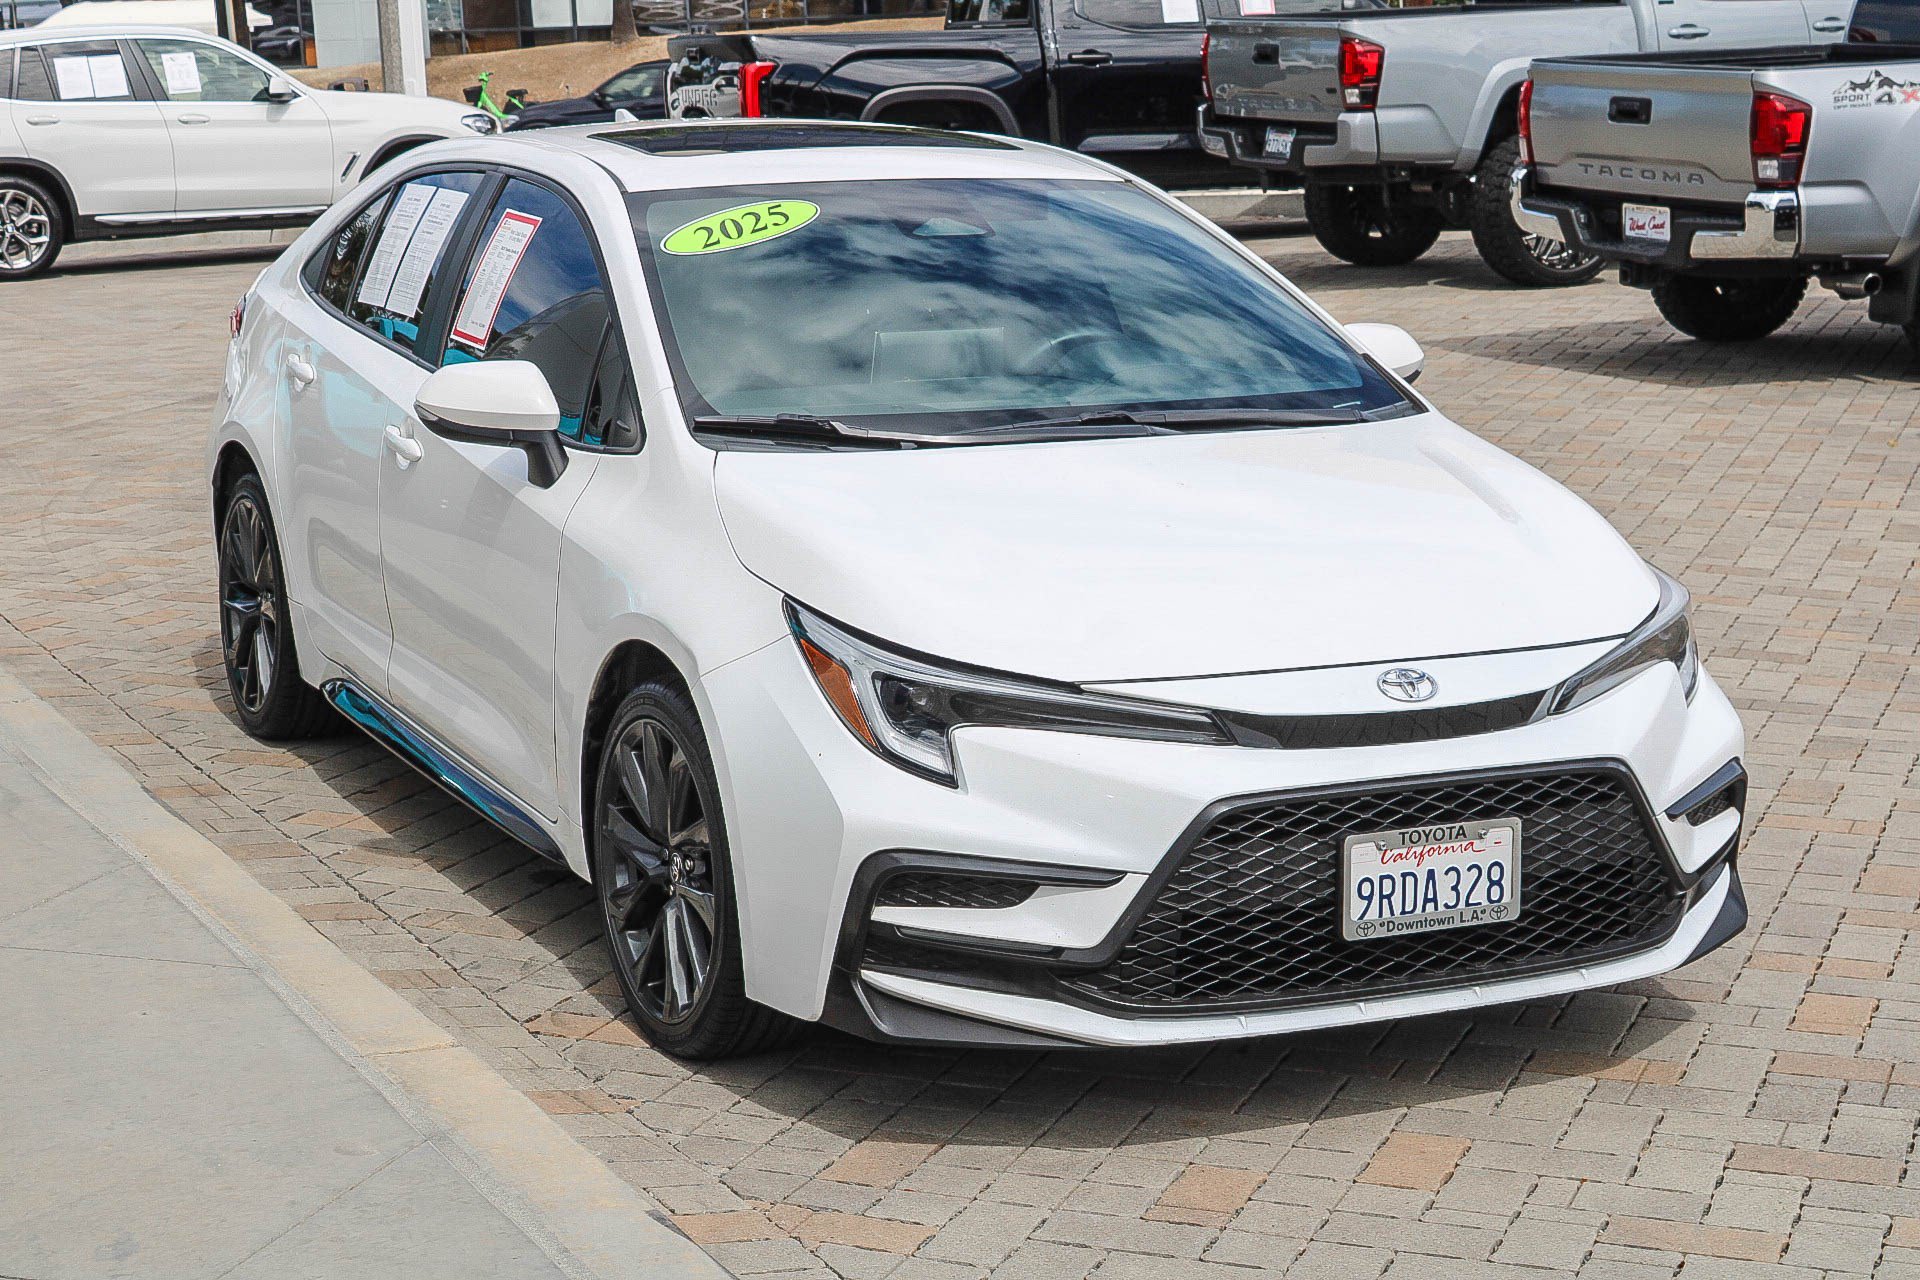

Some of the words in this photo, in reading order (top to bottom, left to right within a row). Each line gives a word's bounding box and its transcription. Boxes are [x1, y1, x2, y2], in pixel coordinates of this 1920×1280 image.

[1833, 93, 1871, 103] SPORT
[1578, 162, 1705, 185] TACOMA
[693, 203, 790, 249] 2025
[1398, 824, 1468, 845] TOYOTA
[1380, 840, 1486, 867] California
[1356, 860, 1505, 921] 9RDA328
